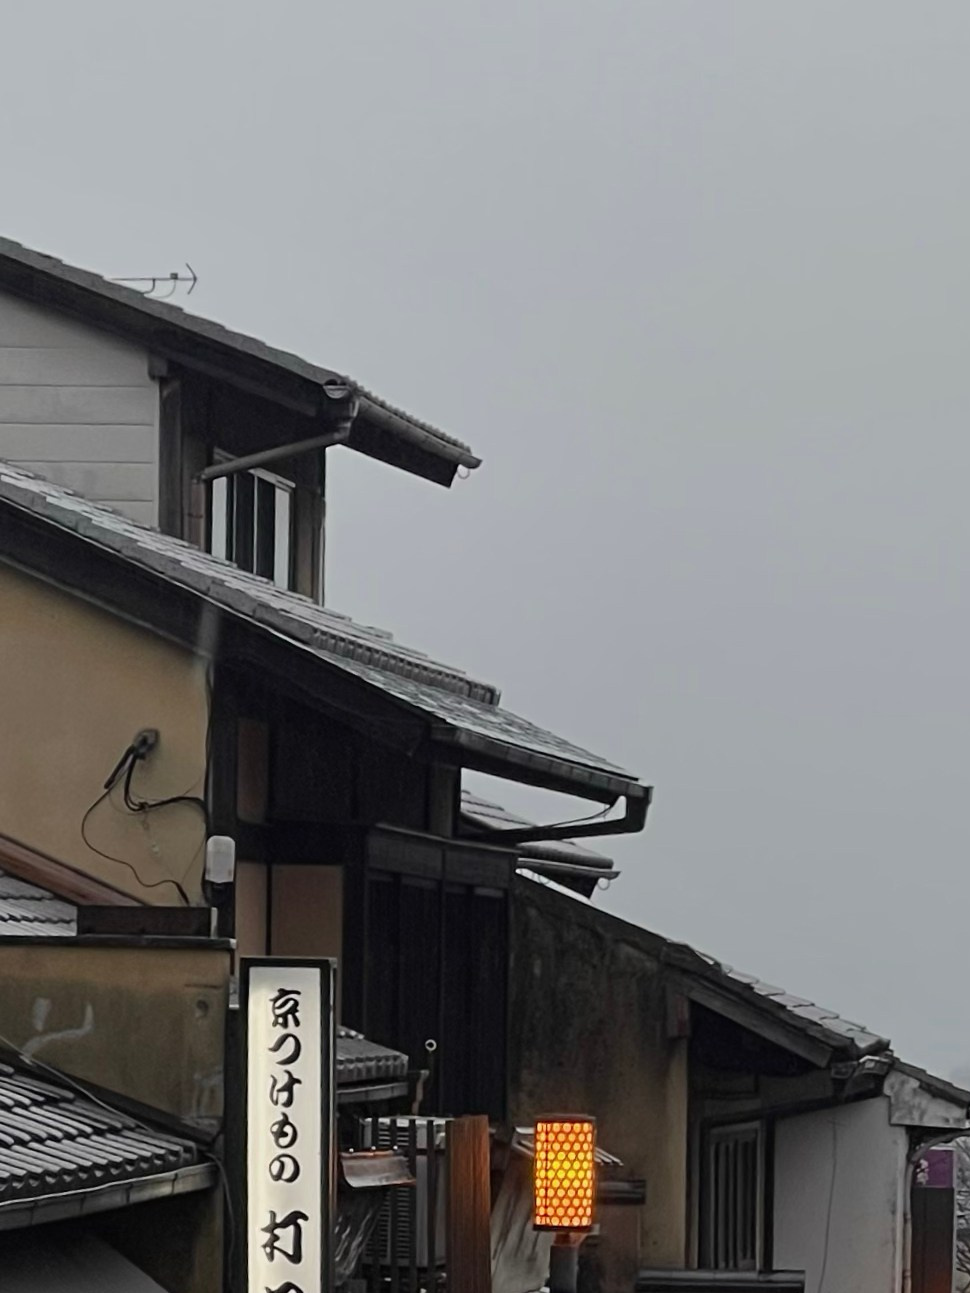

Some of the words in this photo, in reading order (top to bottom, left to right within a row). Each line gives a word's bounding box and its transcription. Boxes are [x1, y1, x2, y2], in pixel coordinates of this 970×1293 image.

[268, 987, 302, 1183] 京つけもの
